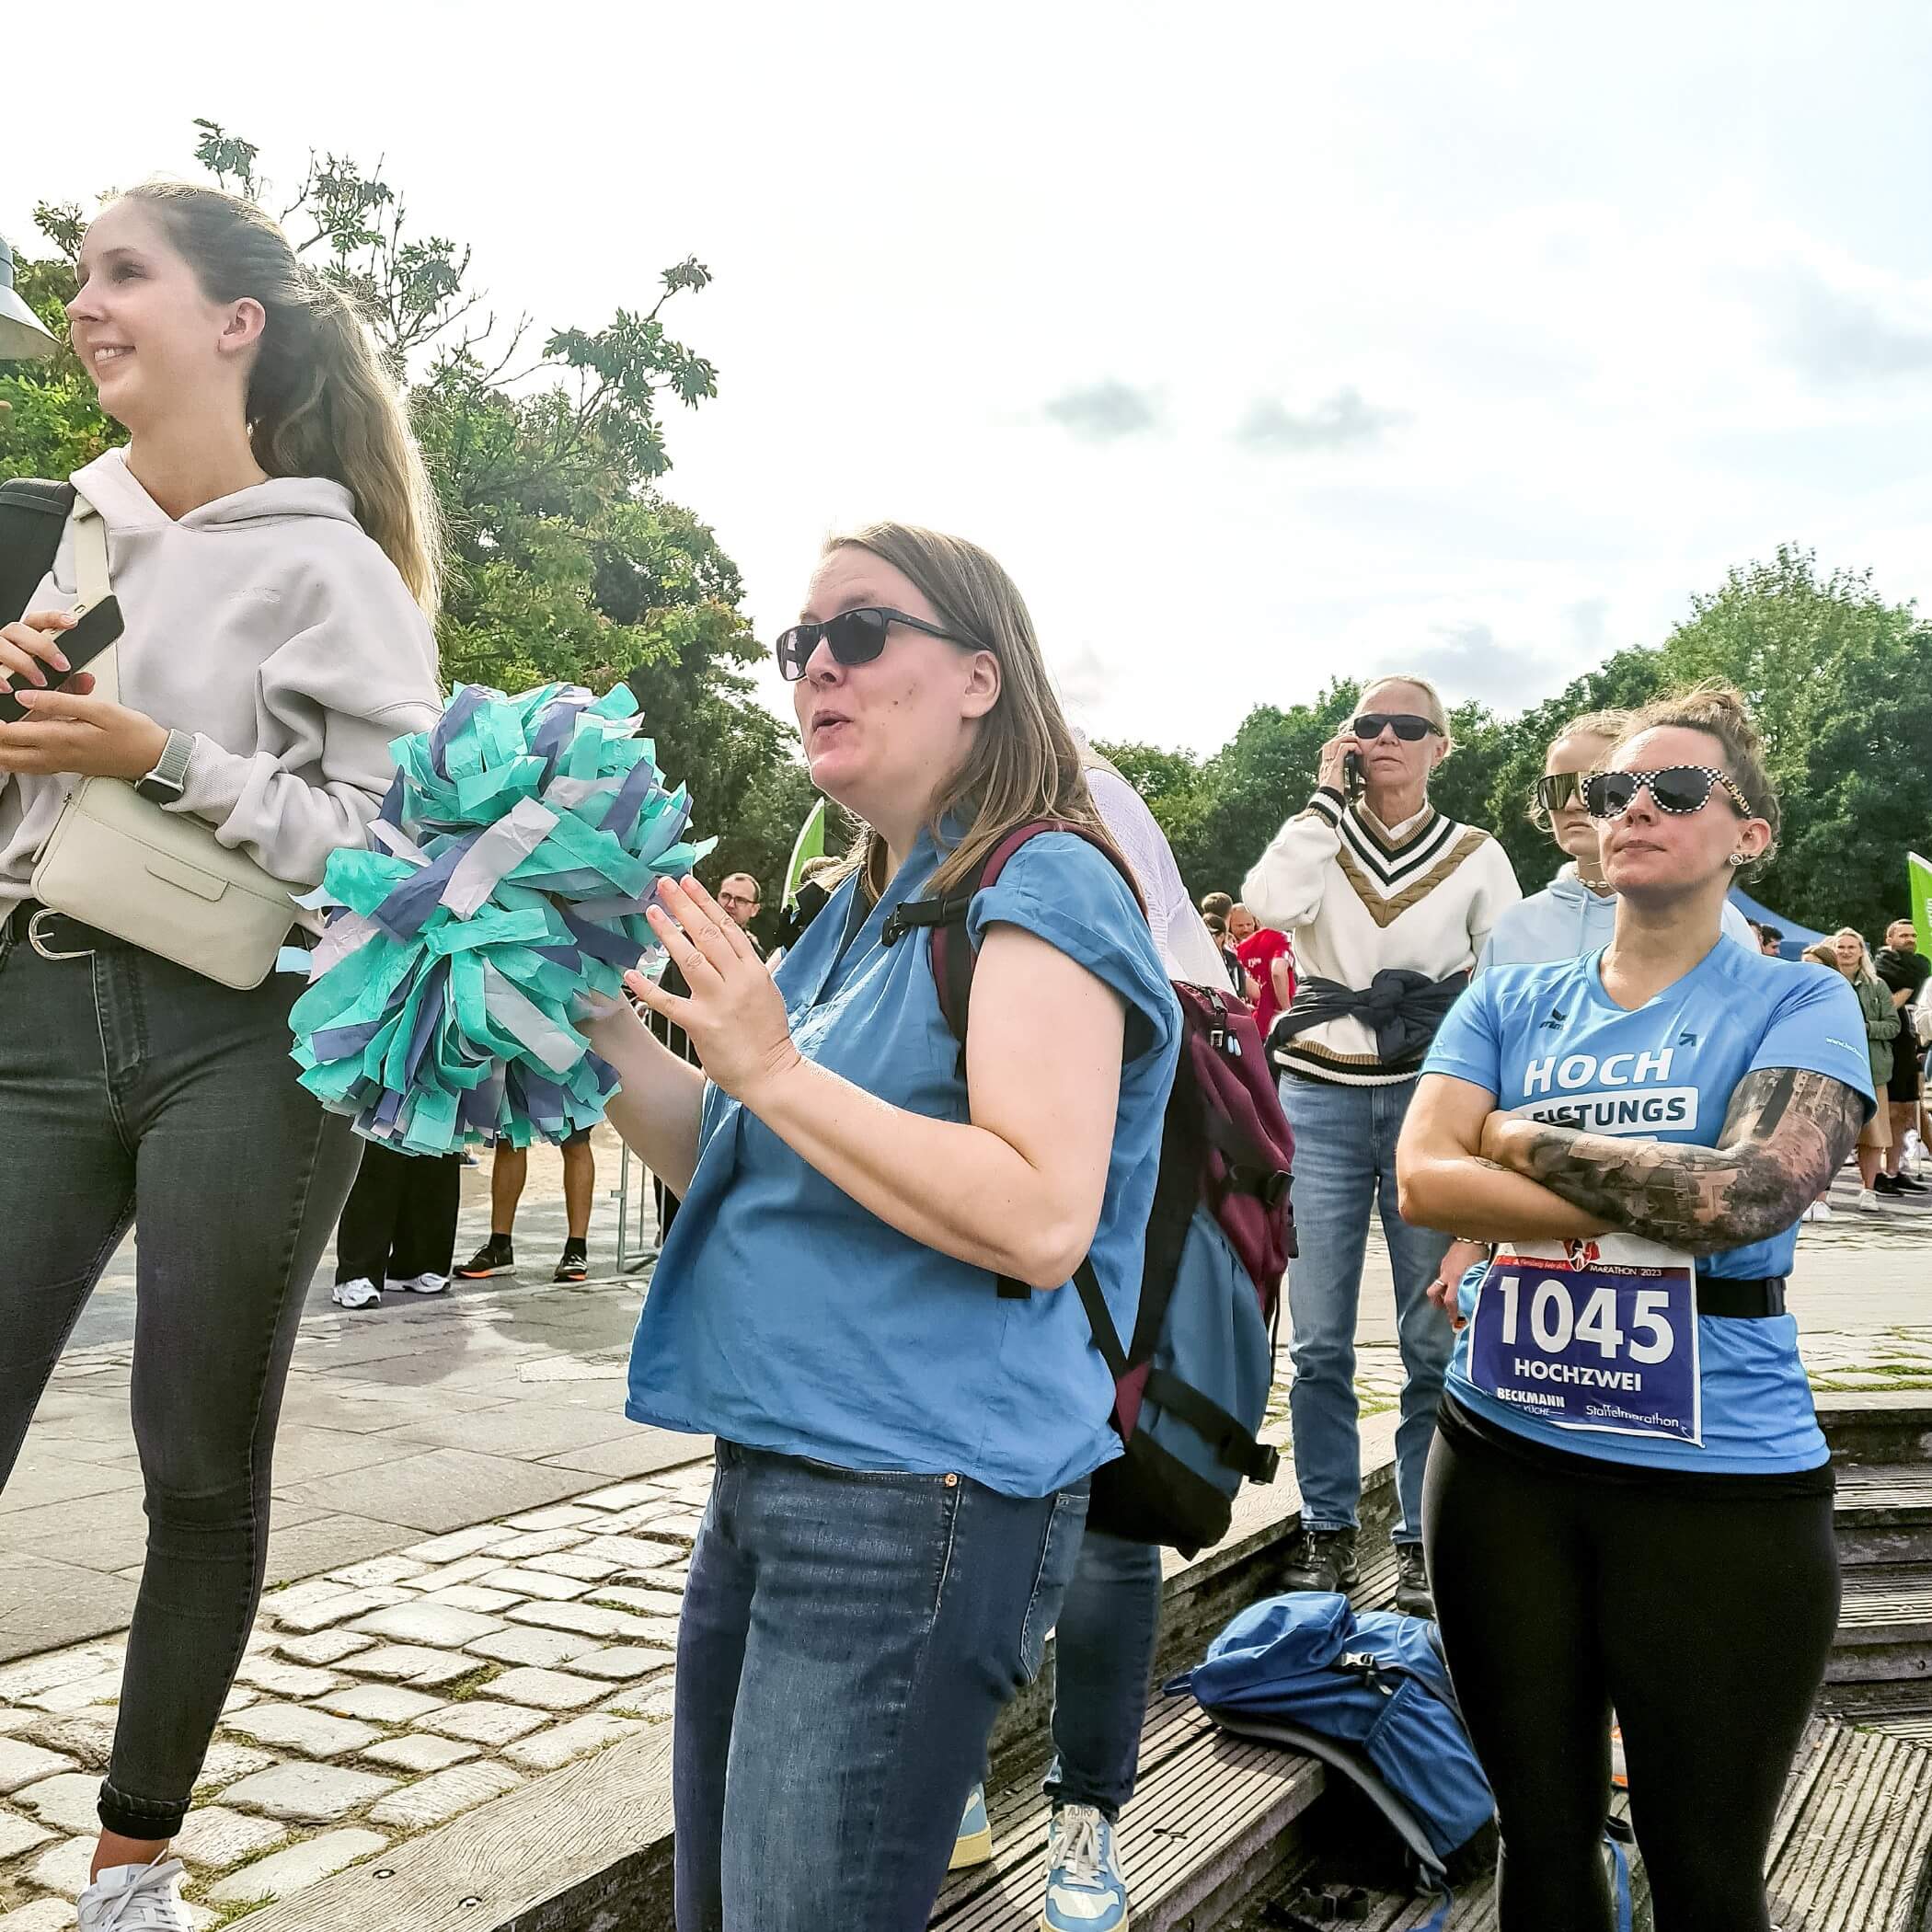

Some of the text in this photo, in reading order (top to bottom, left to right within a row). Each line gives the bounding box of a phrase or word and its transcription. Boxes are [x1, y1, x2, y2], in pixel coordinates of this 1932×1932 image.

[1524, 1047, 1673, 1097] HOCH
[1532, 1097, 1686, 1129] EISTUNGS
[1590, 1264, 1662, 1277] MARATHON 2023
[1499, 1276, 1674, 1364] 1045
[1514, 1358, 1641, 1392] HOCHZWEI
[1497, 1386, 1565, 1408] BECKMANN
[1586, 1404, 1679, 1428] Staffelmarathon
